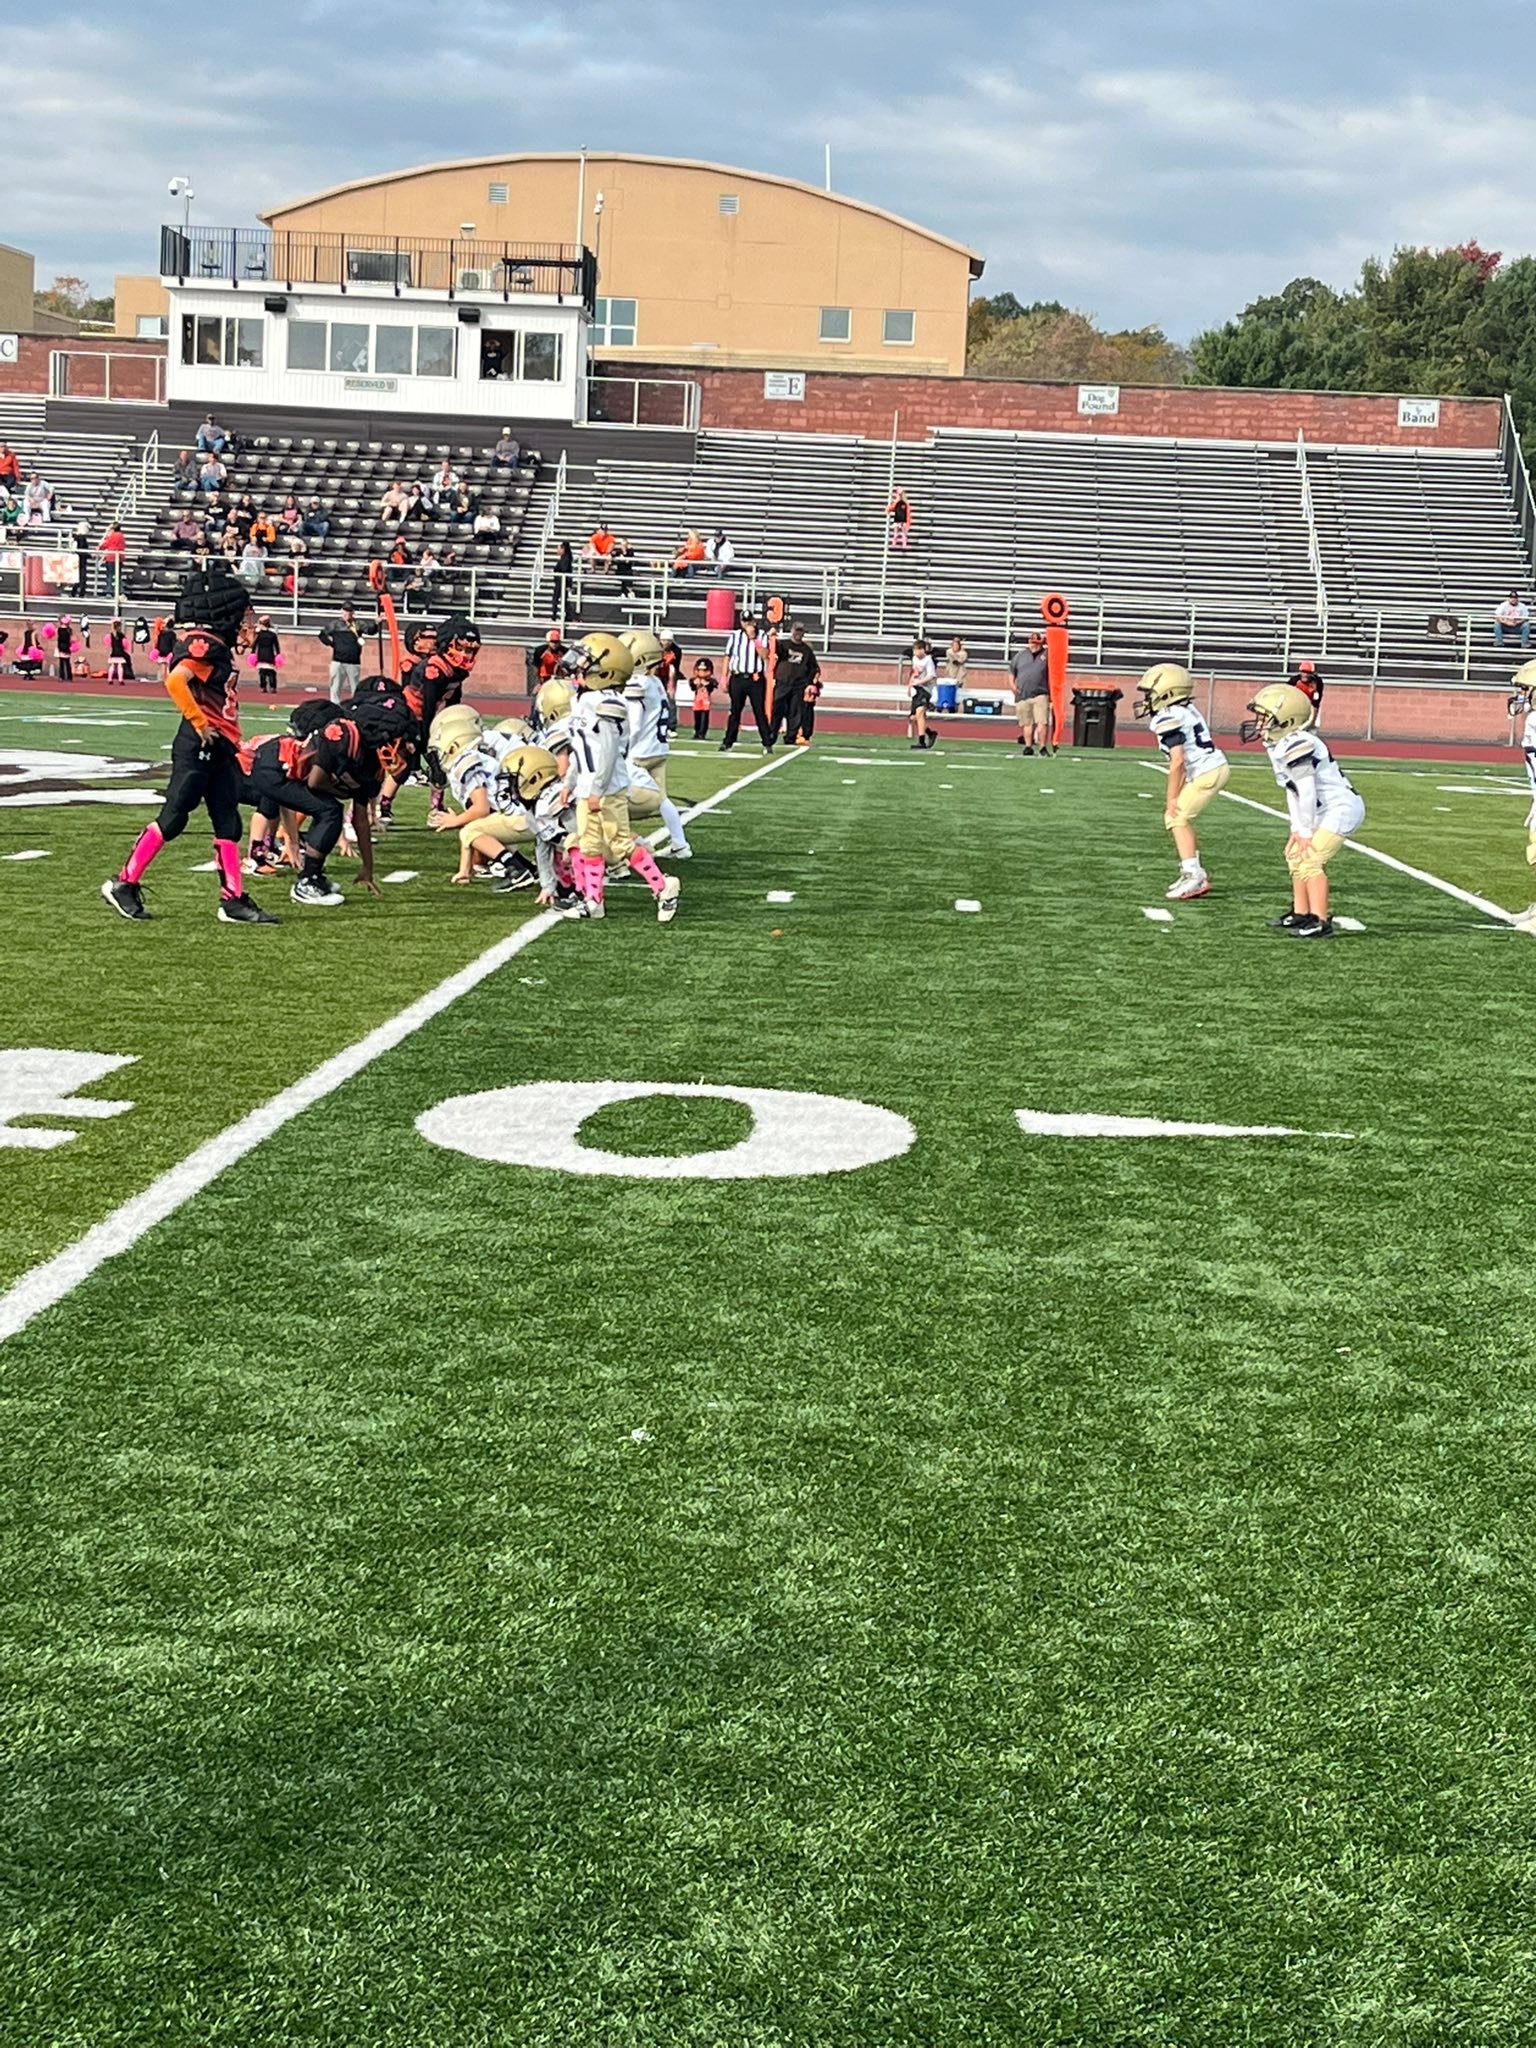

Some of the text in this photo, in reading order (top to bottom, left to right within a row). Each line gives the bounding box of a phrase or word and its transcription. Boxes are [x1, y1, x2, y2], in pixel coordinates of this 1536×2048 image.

[1, 338, 14, 358] C
[787, 376, 802, 396] E
[1088, 393, 1106, 403] Dog
[1081, 401, 1115, 410] Pound
[1402, 411, 1435, 423] Band
